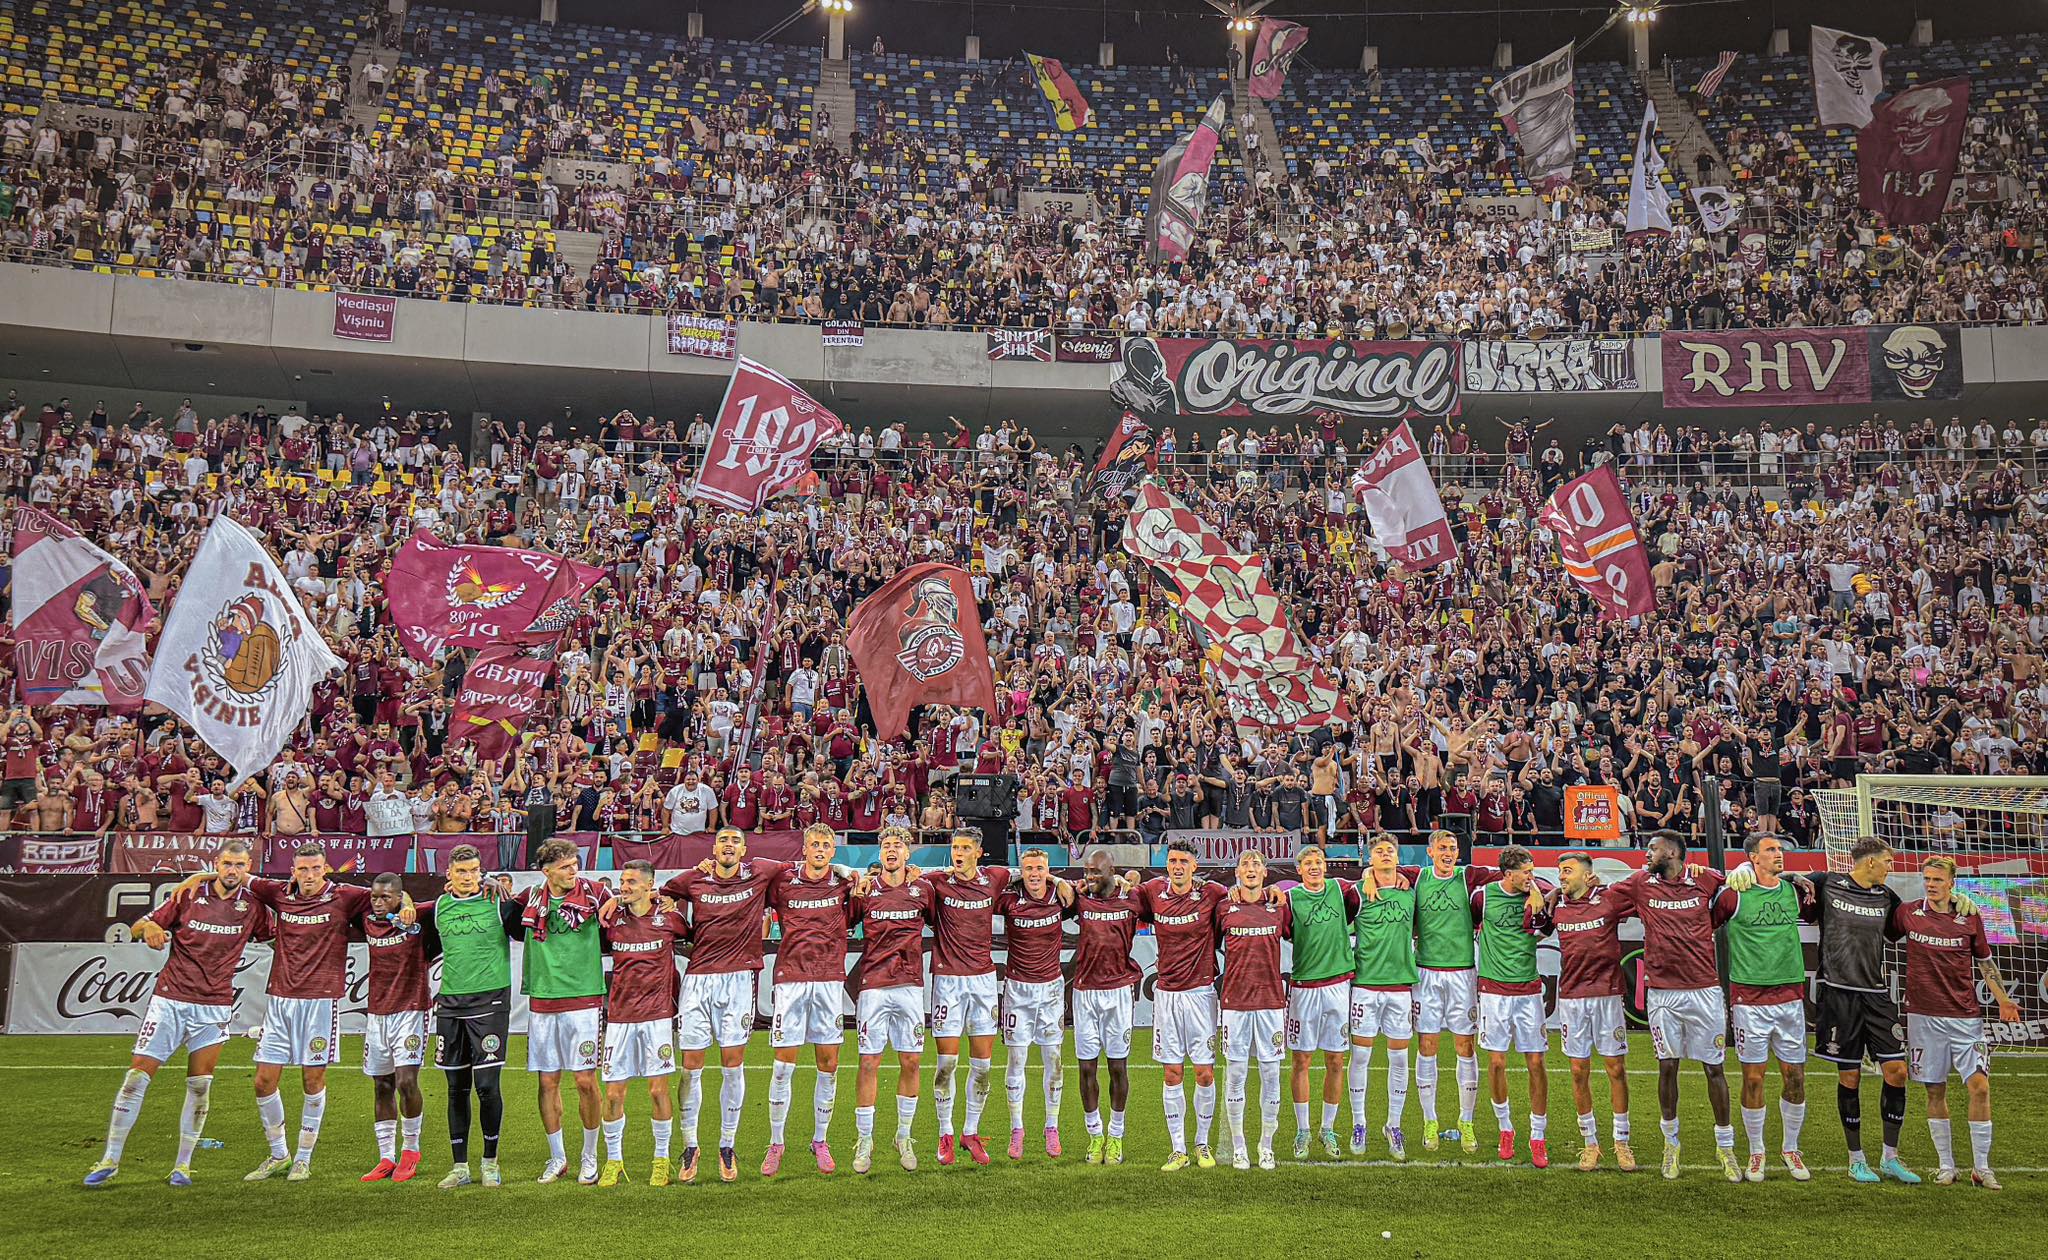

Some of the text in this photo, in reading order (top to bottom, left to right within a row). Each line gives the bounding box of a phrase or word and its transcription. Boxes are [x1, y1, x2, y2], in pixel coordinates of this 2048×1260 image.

[574, 168, 608, 182] 354
[1044, 201, 1073, 212] 352
[1487, 205, 1519, 216] 350
[1679, 338, 1847, 396] RHV
[1184, 340, 1458, 417] Original
[122, 834, 180, 849] ALBA
[24, 842, 99, 861] RAPID
[700, 887, 754, 904] SUPERBET
[788, 897, 839, 909] SUPERBET
[1649, 896, 1700, 910] SUPERBET
[944, 897, 993, 910] SUPERBET
[1831, 899, 1886, 918] SUPERBET
[281, 911, 331, 925] SUPERBET
[870, 909, 919, 920] SUPERBET
[1014, 912, 1062, 928] SUPERBET
[1083, 909, 1130, 921] SUPERBET
[1153, 912, 1200, 925] SUPERBET
[188, 919, 243, 935] SUPERBET
[1230, 925, 1277, 936] SUPERBET
[1557, 917, 1605, 932] SUPERBET
[612, 939, 663, 952] SUPERBET
[1908, 930, 1964, 947] SUPERBET
[934, 1005, 947, 1020] 29
[1351, 1003, 1363, 1018] 55
[775, 1014, 782, 1029] 9
[1004, 1014, 1016, 1028] 10
[1289, 1018, 1300, 1034] 98
[141, 1021, 156, 1037] 95
[1831, 1027, 1836, 1041] 1
[1911, 1048, 1924, 1063] 17
